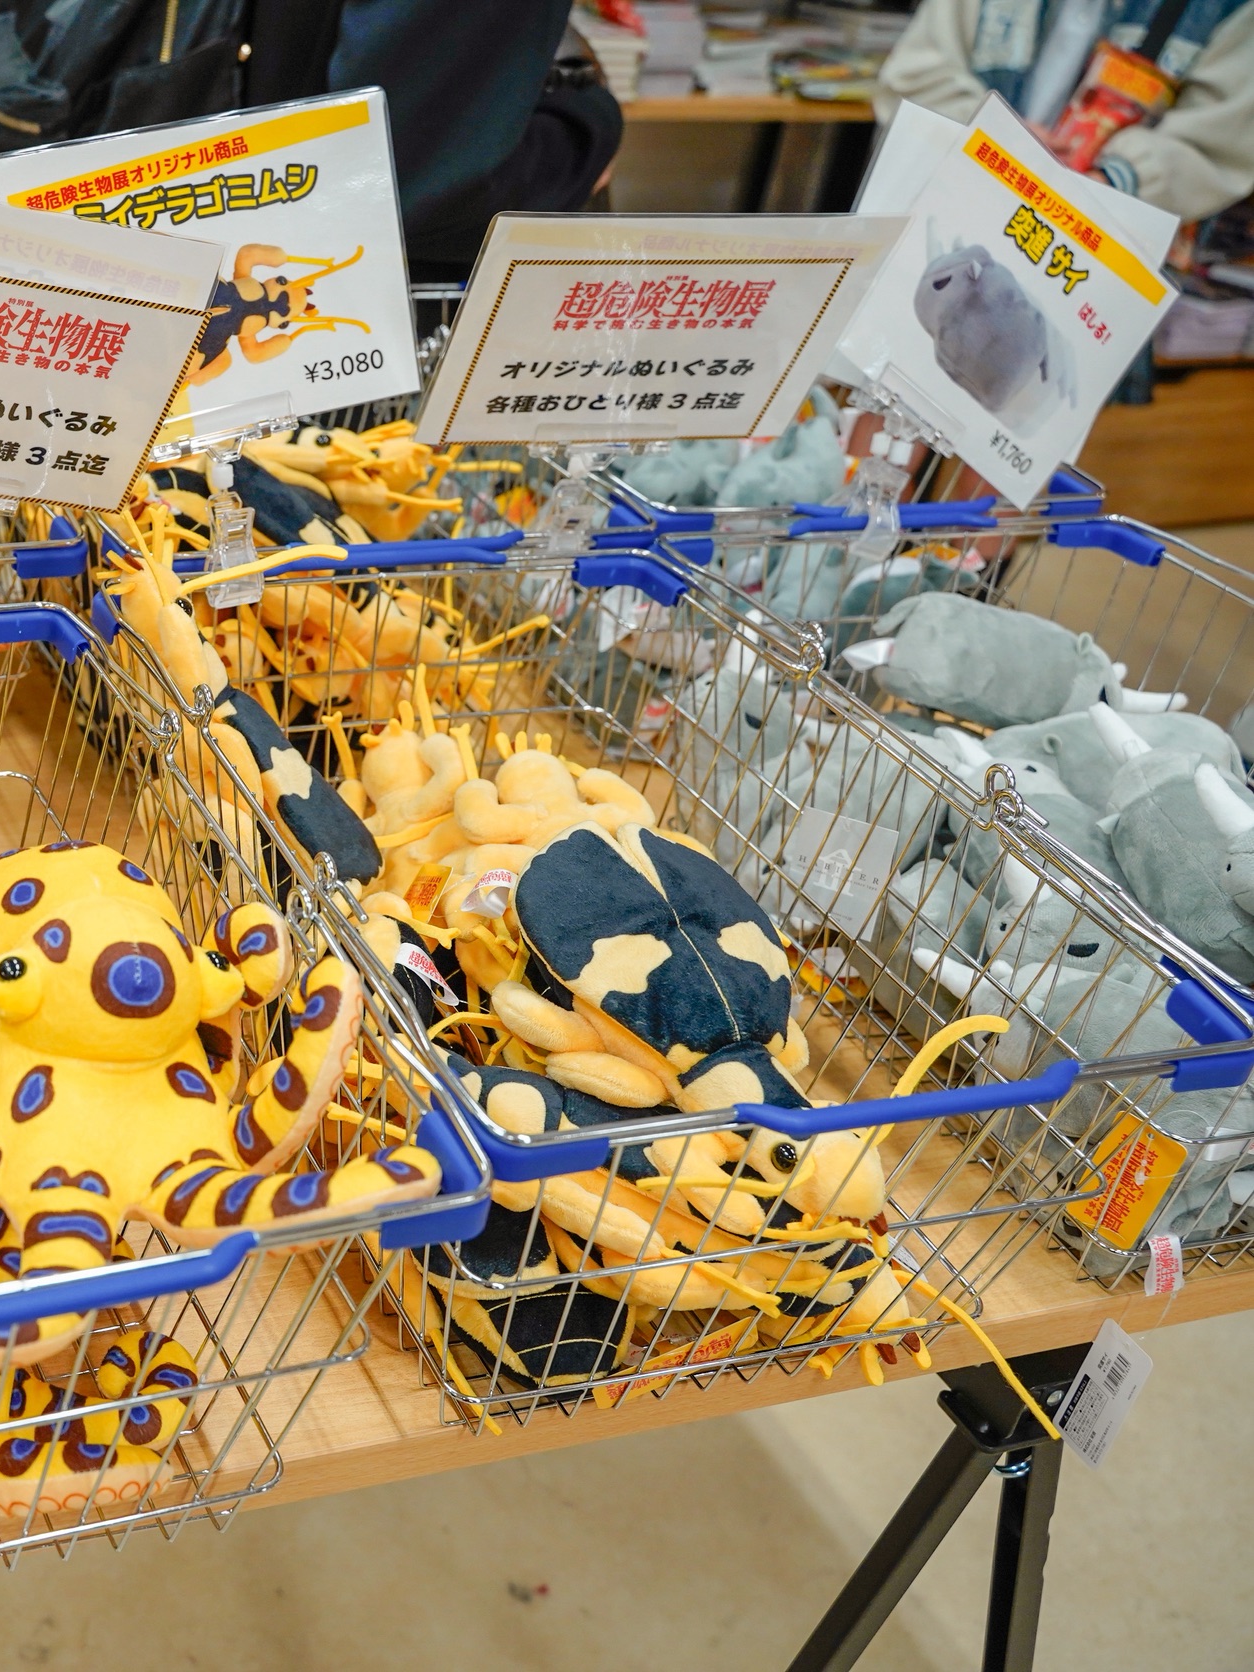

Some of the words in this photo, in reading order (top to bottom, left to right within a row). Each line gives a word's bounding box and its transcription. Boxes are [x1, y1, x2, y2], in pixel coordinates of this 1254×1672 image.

[26, 136, 248, 210] 超危険生物展オリジナル商品
[975, 141, 1103, 252] 超危険生物展オリジナル商品
[553, 279, 777, 319] 超危険生物展
[303, 349, 384, 383] ¥3,080
[500, 359, 756, 379] オリジナルぬいぐるみ
[989, 429, 1033, 475] ¥1,760
[798, 855, 879, 886] HBIER
